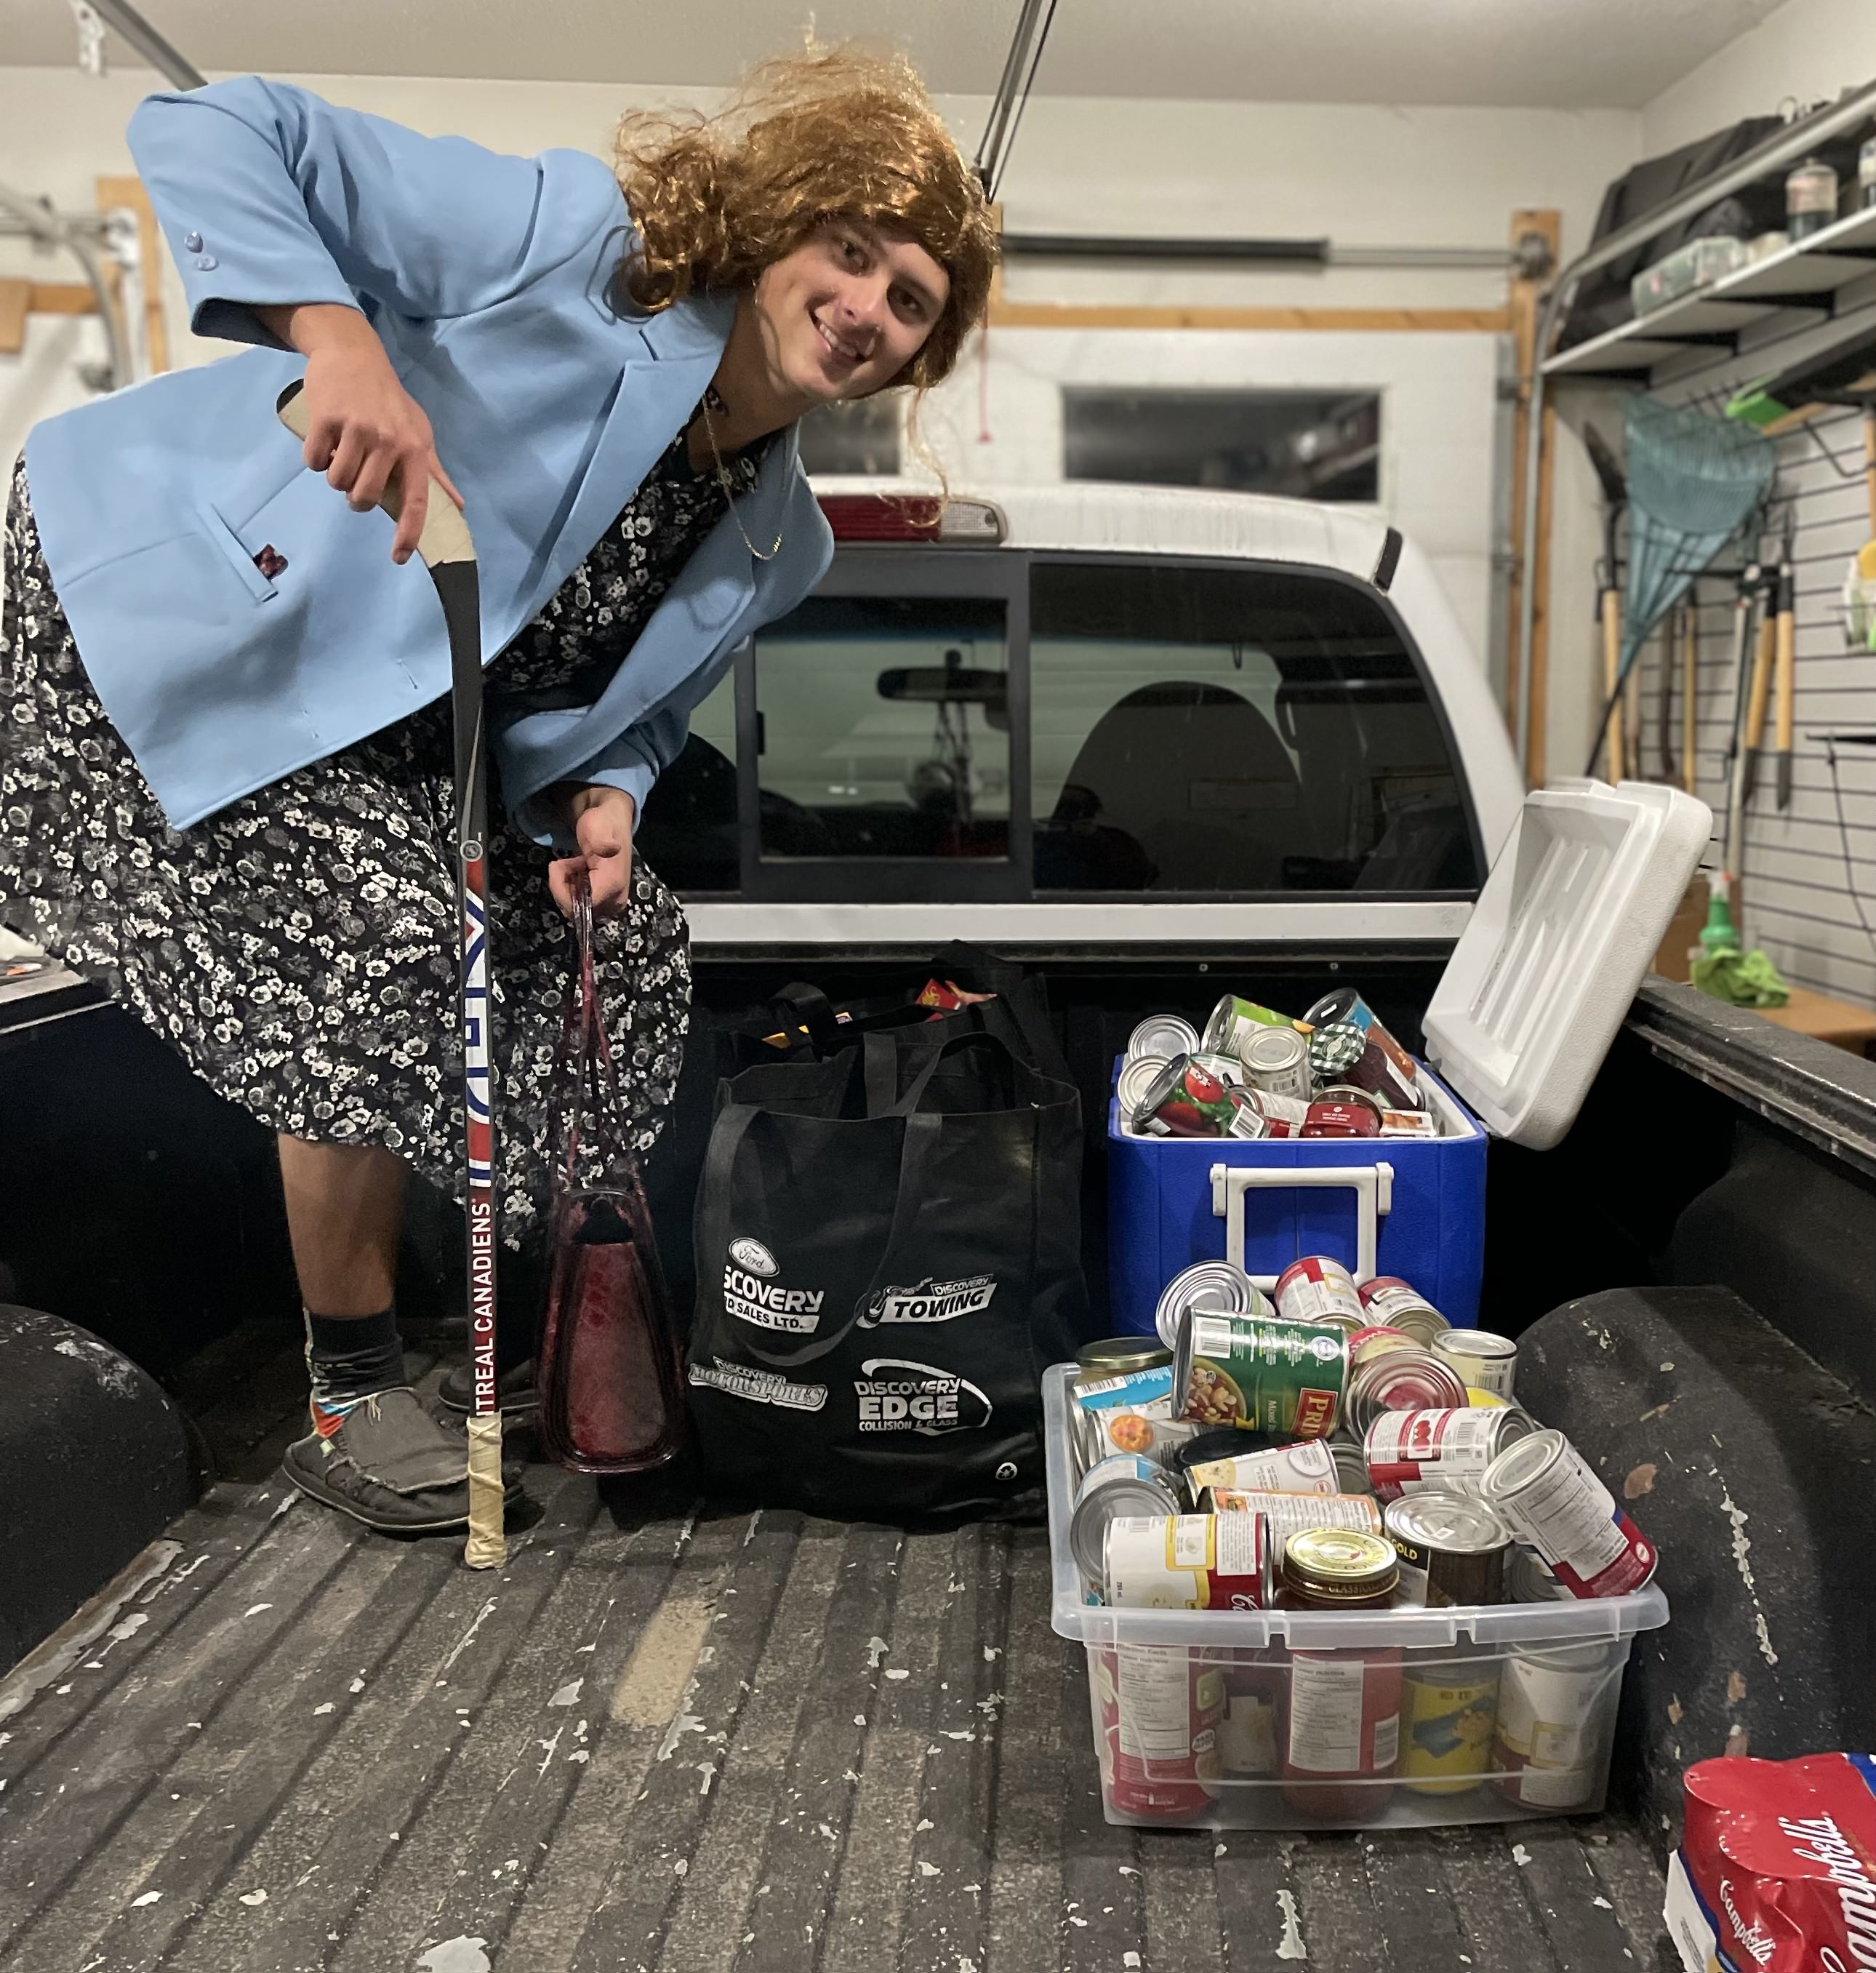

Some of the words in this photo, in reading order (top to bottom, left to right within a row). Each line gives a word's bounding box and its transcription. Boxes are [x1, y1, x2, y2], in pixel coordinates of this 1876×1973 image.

[471, 1201, 494, 1332] CANADIENS
[739, 1244, 765, 1270] Ford
[934, 1276, 990, 1296] DISCOVERY
[737, 1302, 770, 1324] SALES
[774, 1316, 803, 1329] LTD.
[894, 1289, 986, 1318] TOWING
[692, 1364, 825, 1404] MOTORSPORTS
[715, 1359, 782, 1384] DISCOVERY
[854, 1377, 961, 1396] DISCOVERY
[859, 1394, 958, 1420] EDGE
[859, 1420, 913, 1432] COLLISION
[915, 1420, 923, 1428] &
[926, 1418, 958, 1427] GLASS
[1390, 1537, 1418, 1561] GOLD
[1777, 1814, 1876, 1973] ampbell's
[1720, 1878, 1776, 1966] Campbell's
